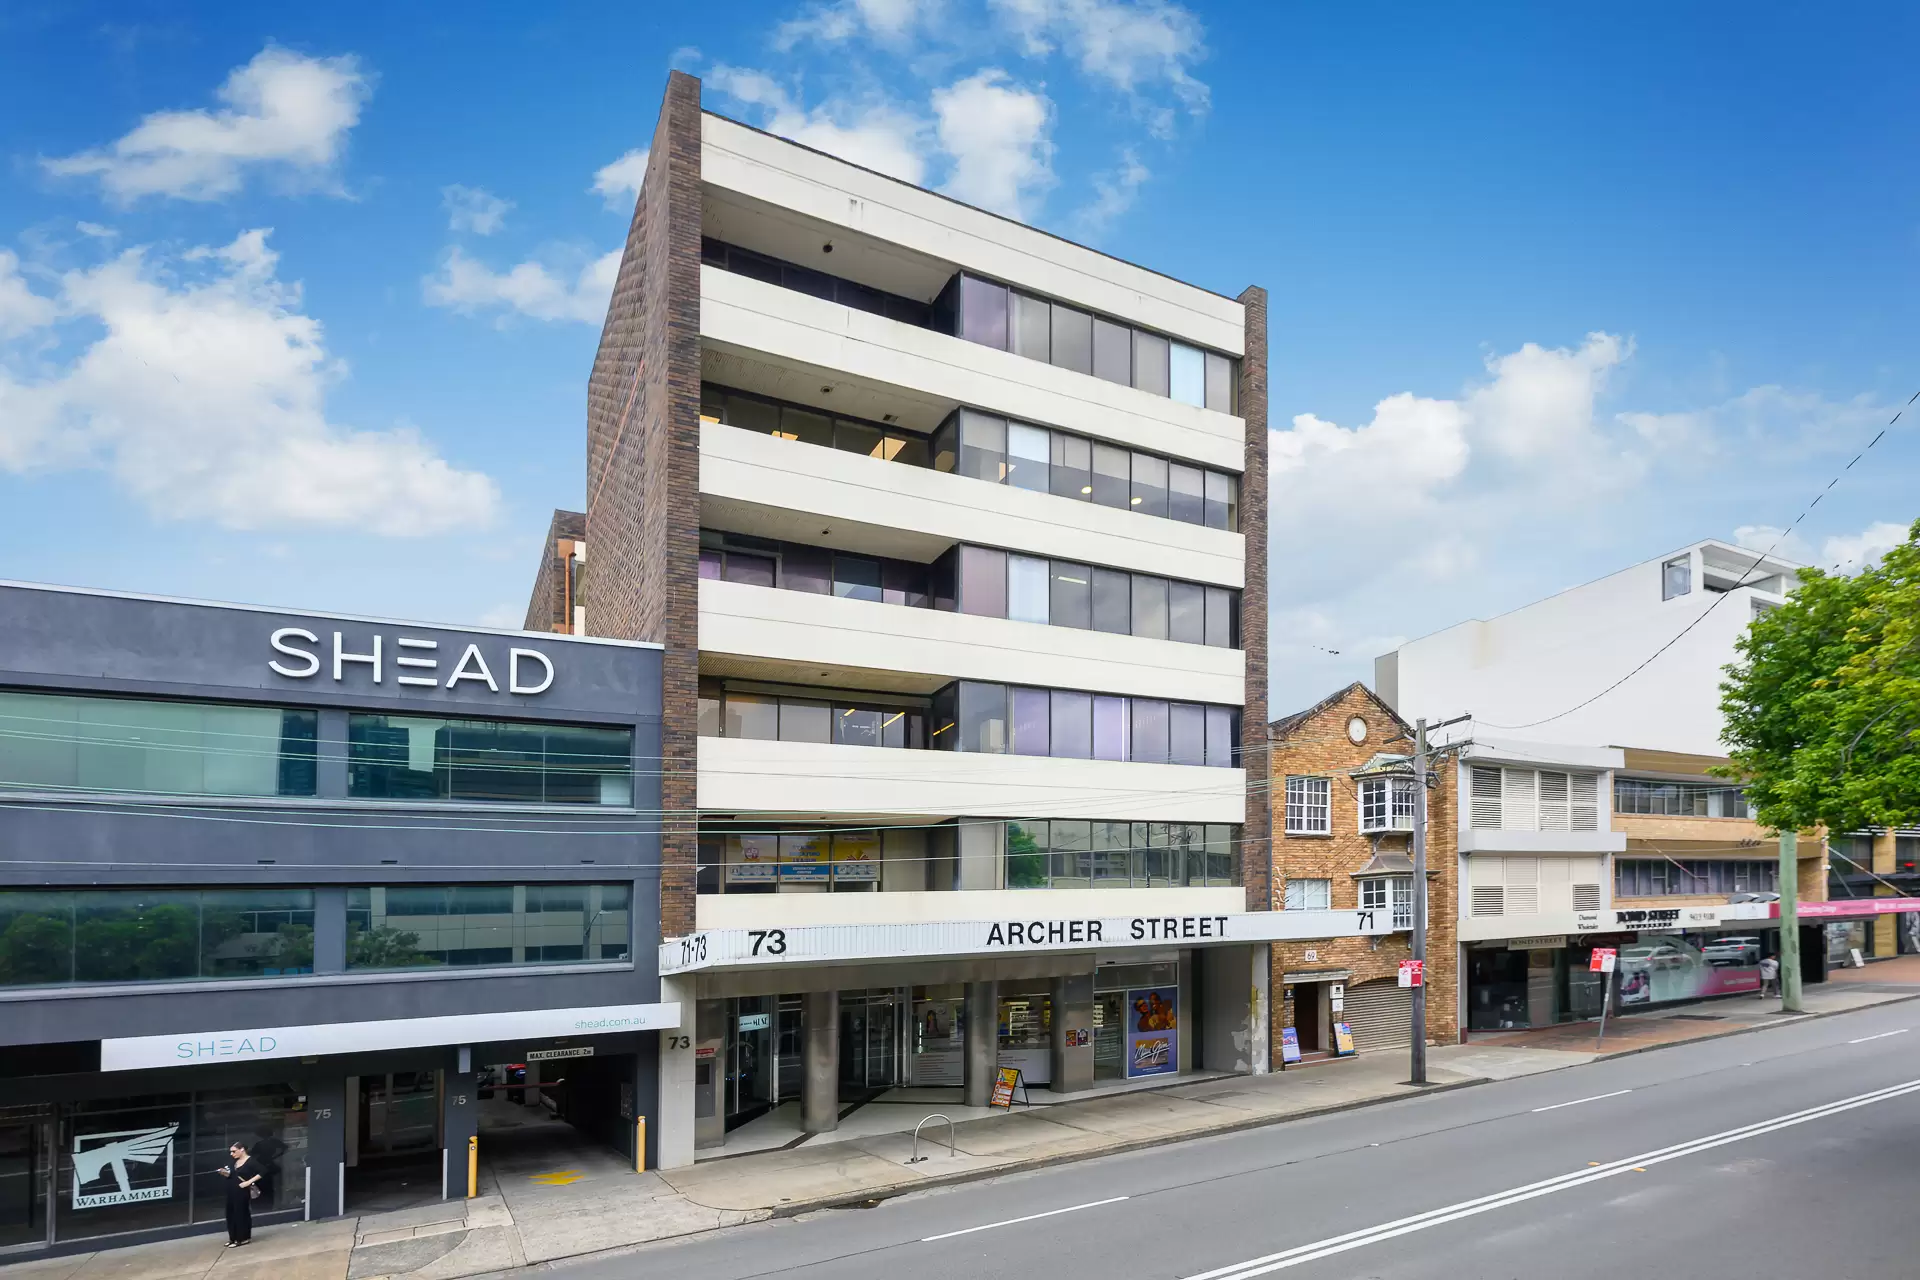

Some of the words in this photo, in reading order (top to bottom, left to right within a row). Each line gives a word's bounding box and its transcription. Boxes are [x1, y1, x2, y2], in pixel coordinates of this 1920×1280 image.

[268, 627, 555, 695] SHEAD
[1357, 912, 1373, 930] 71
[1616, 911, 1646, 923] BOND
[986, 920, 1103, 946] ARCHER
[1130, 916, 1228, 940] STREET
[681, 934, 707, 965] 71-73
[748, 929, 787, 957] 73
[1307, 952, 1315, 960] 69
[575, 1016, 646, 1030] shead.com.au
[177, 1036, 277, 1059] SHEAD
[668, 1035, 691, 1050] 73
[529, 1052, 545, 1060] MAX.
[546, 1049, 580, 1058] CLEARANCE
[452, 1095, 467, 1106] 75
[314, 1108, 332, 1120] 75
[76, 1188, 170, 1207] WARHAMMER
